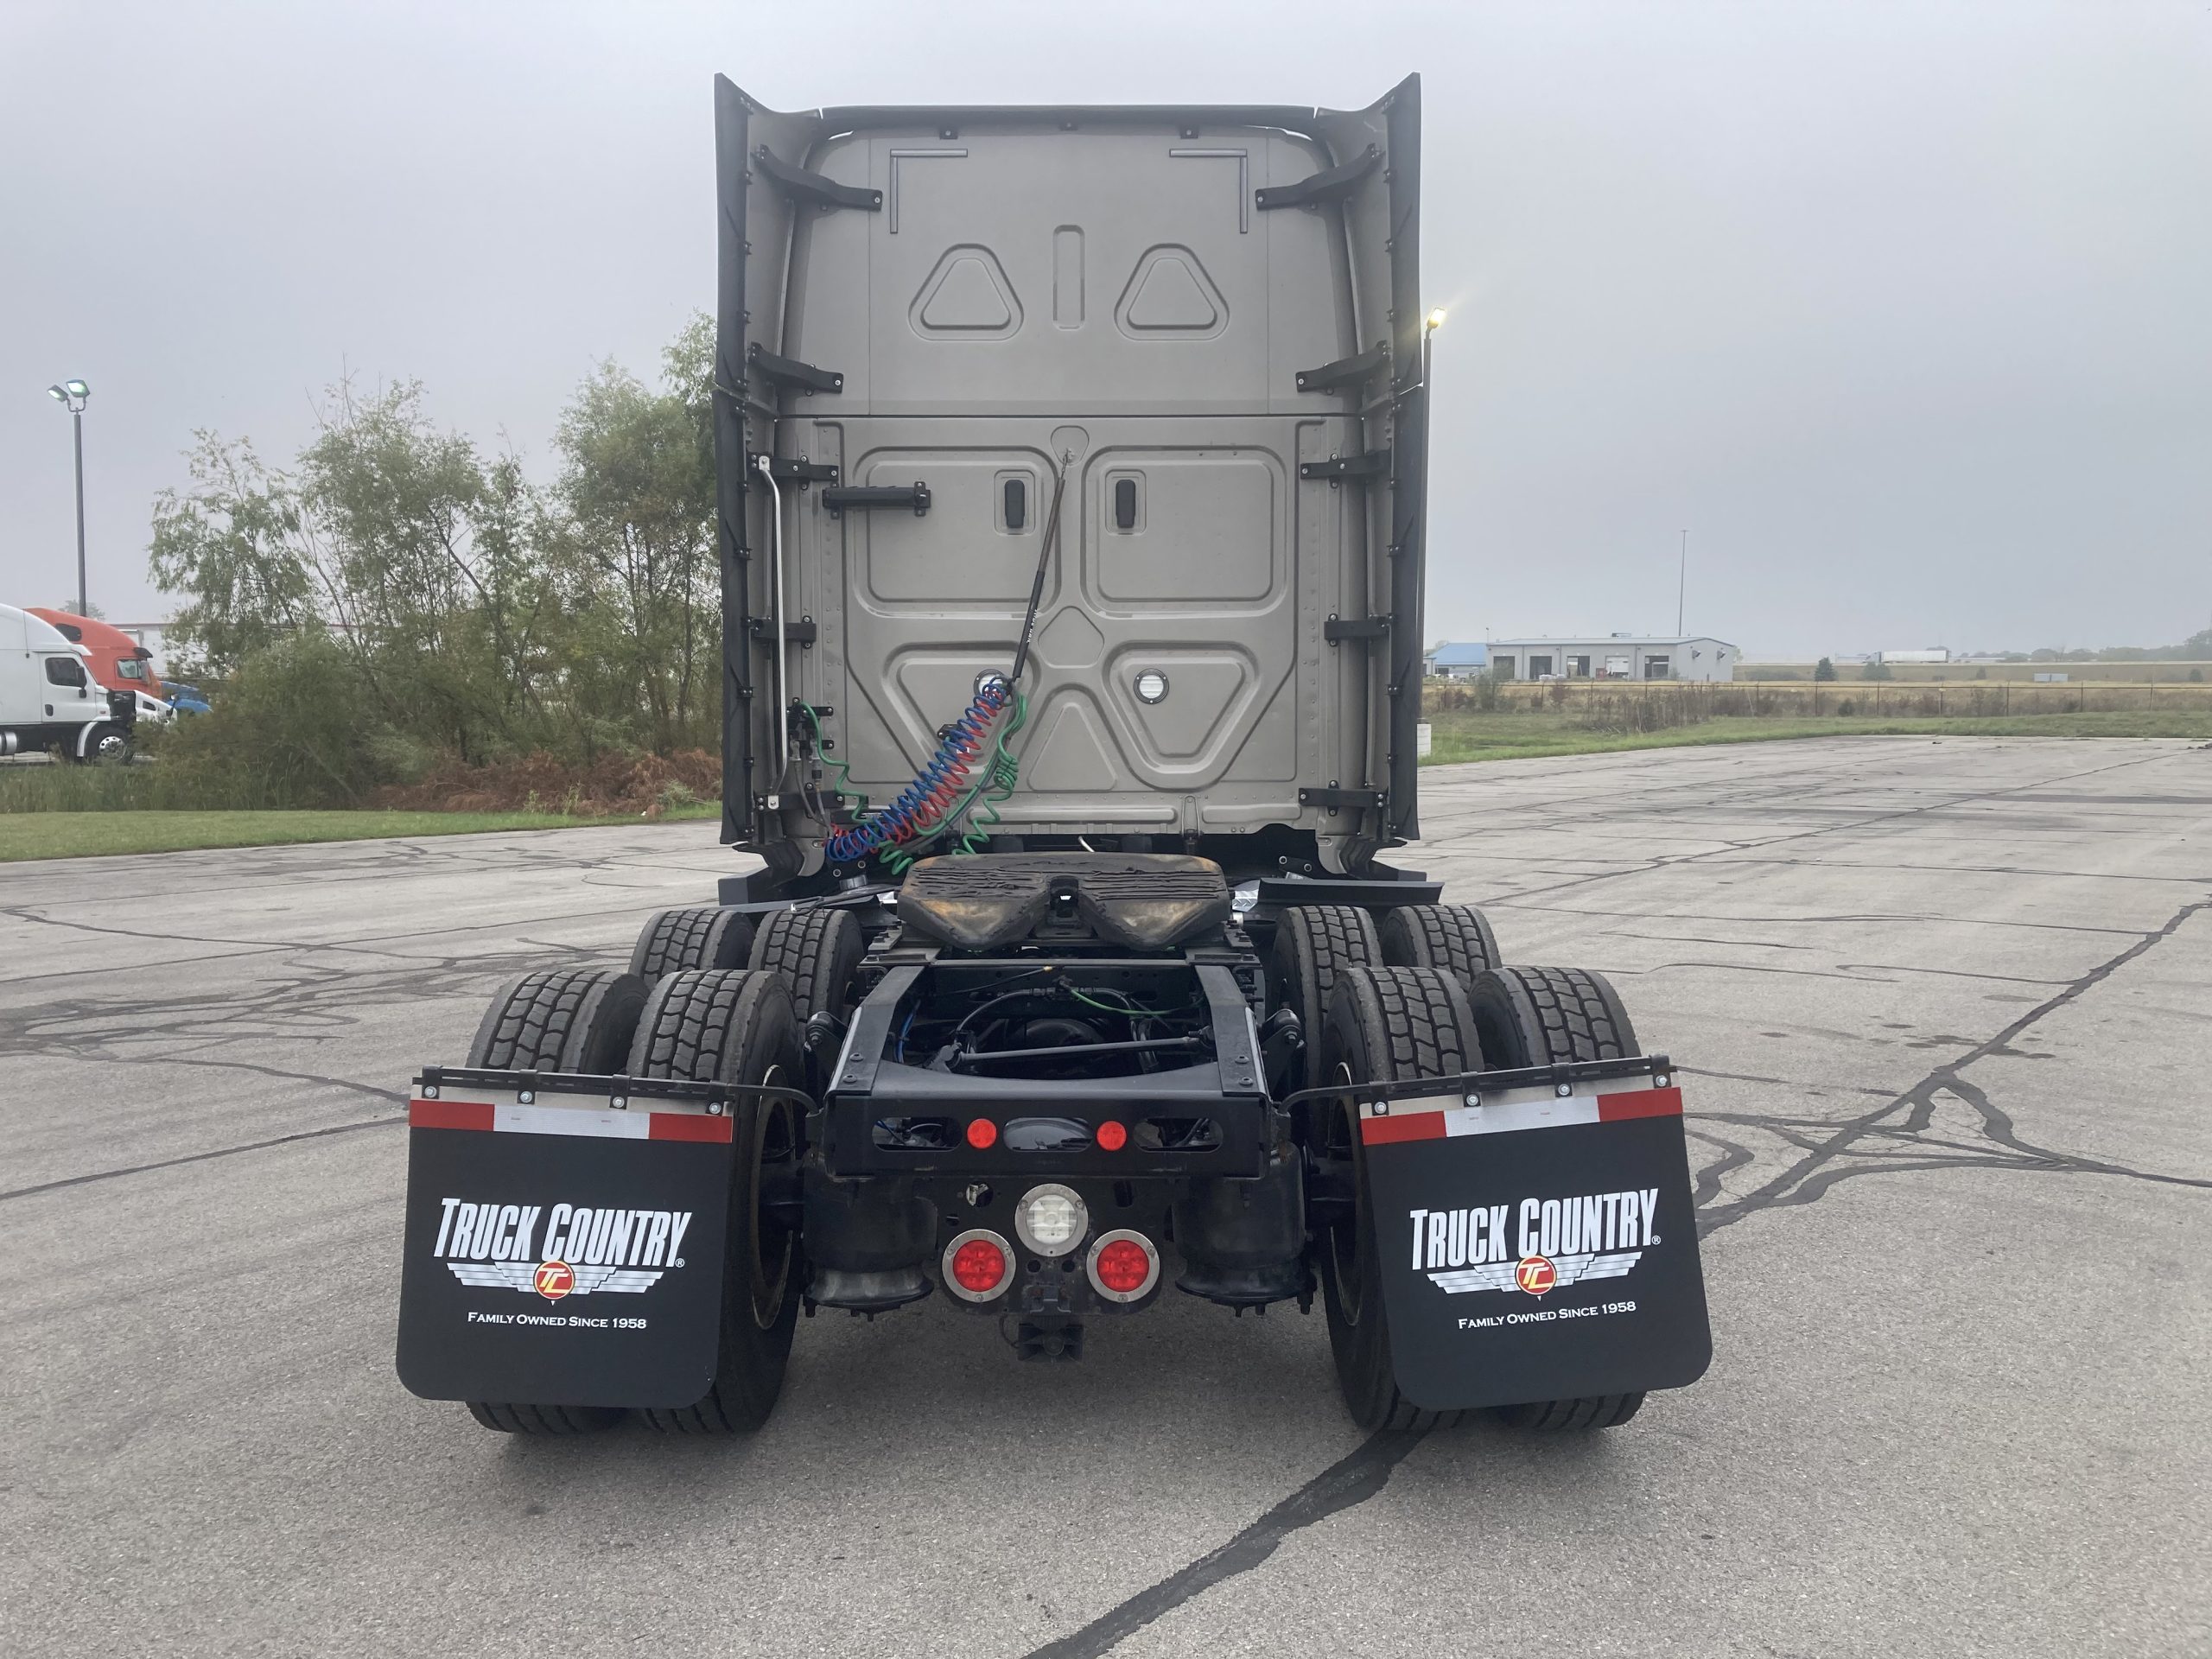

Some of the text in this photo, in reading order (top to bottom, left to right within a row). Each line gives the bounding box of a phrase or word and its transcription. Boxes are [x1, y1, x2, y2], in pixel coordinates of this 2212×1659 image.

[433, 1198, 542, 1262] TRUCK
[1409, 1205, 1510, 1270] TRUCK
[538, 1267, 569, 1294] TC
[1520, 1261, 1554, 1290] TC
[467, 1312, 647, 1329] FAMILY OWNED SINCE 1958
[1458, 1300, 1637, 1329] FAMILY OWNED SINCE 1958
